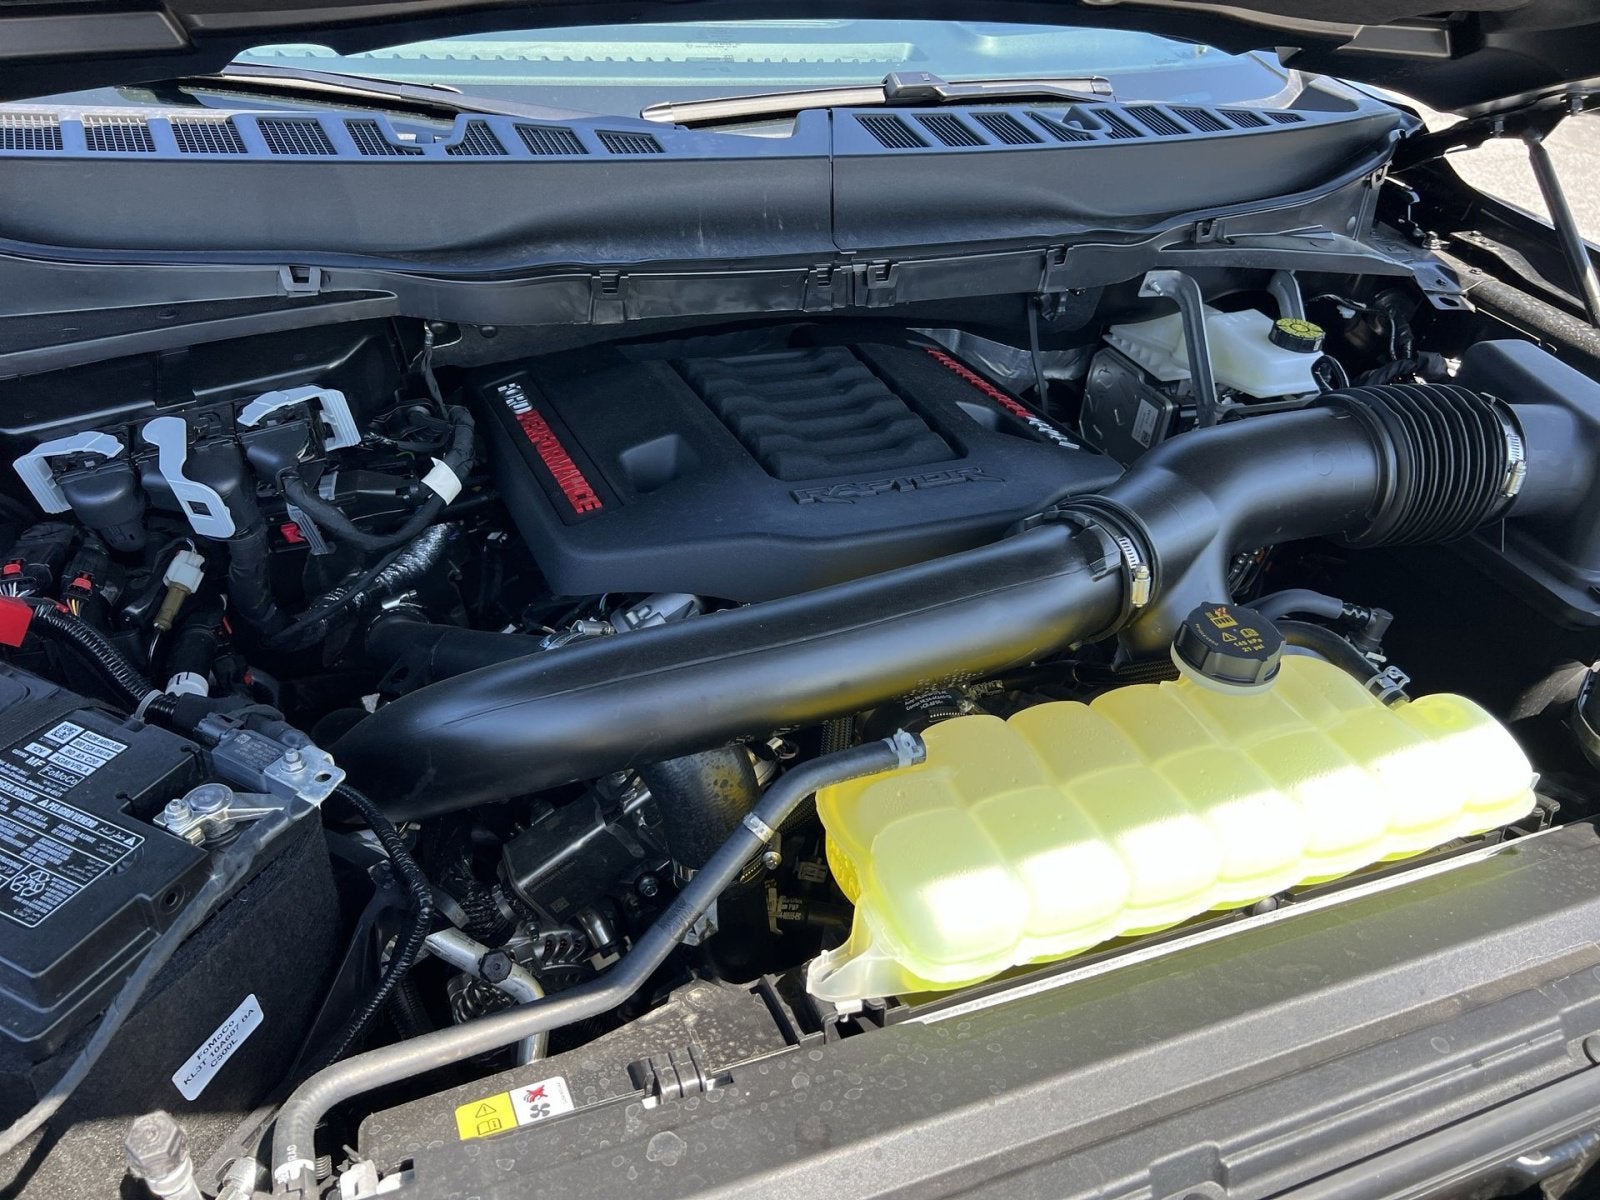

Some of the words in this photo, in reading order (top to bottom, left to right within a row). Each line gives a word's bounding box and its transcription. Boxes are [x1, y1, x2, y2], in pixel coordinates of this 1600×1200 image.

[497, 382, 532, 415] FORD
[516, 409, 603, 514] PERFORMANCE
[32, 746, 46, 754] 12V
[65, 748, 76, 756] 80
[84, 756, 100, 764] C20
[25, 756, 47, 768] MF
[52, 755, 90, 773] AGM/VRLA
[41, 765, 78, 785] FoMoCo
[196, 1020, 235, 1061] FoMoCo
[210, 1038, 239, 1069] C500L
[183, 1057, 208, 1086] KL3T
[286, 1144, 298, 1162] RAD
